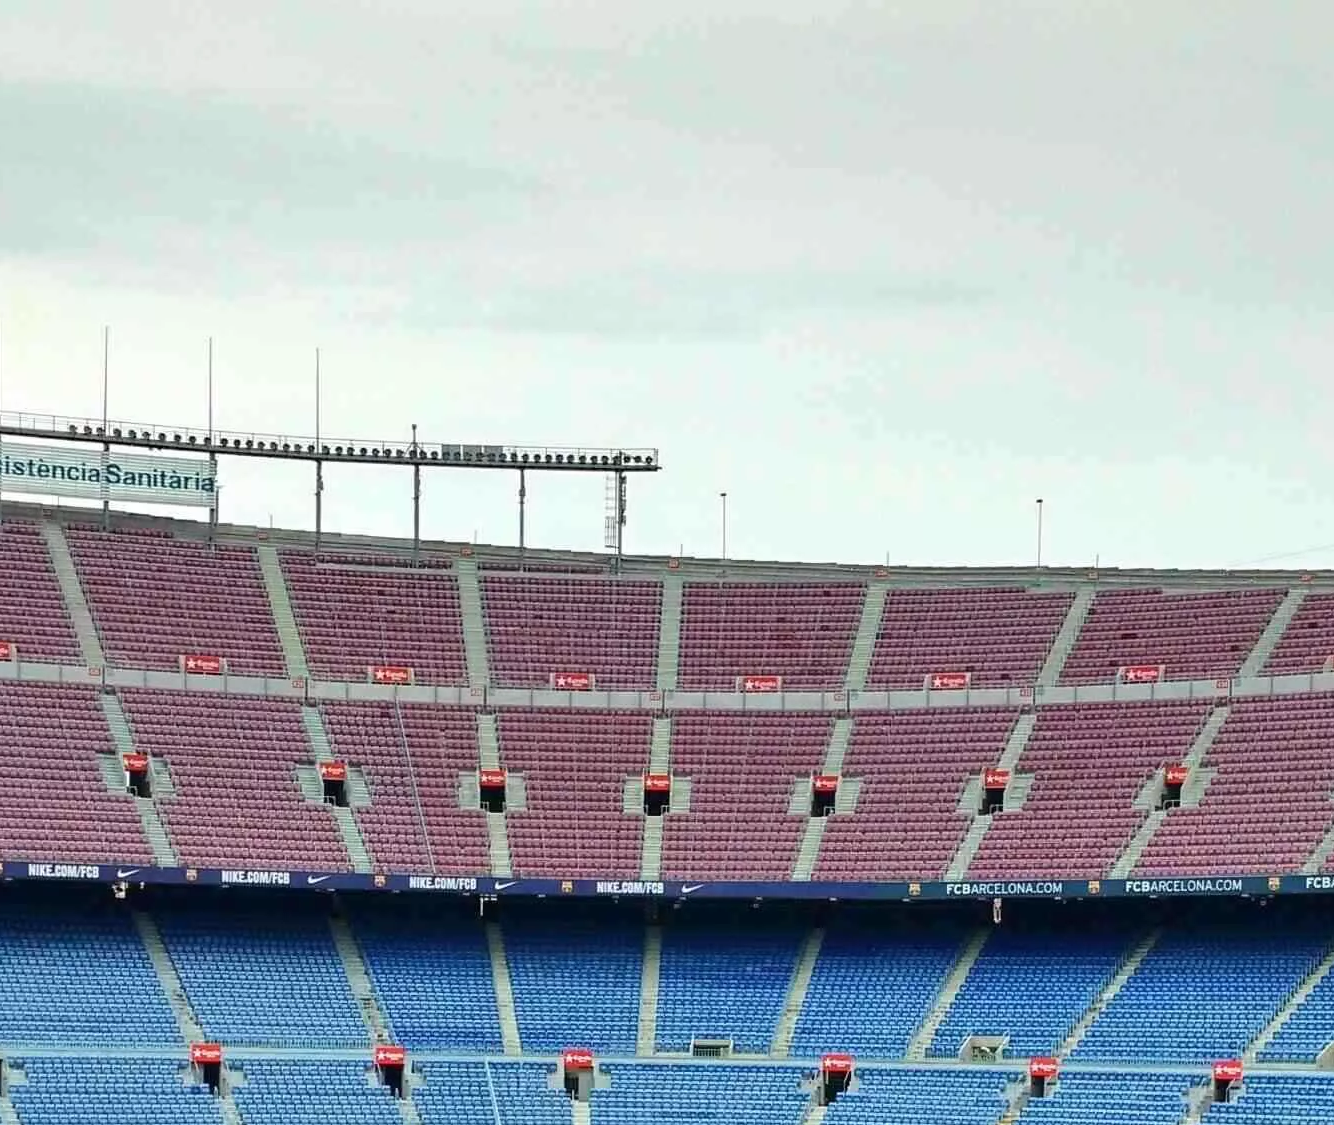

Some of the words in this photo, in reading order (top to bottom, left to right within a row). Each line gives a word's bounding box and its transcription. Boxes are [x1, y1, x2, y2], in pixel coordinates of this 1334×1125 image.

[105, 463, 216, 493] Sanitària
[28, 863, 99, 879] NIKE.COM/FCB
[221, 871, 290, 885] NIKE.COM/FCB
[409, 877, 477, 891] NIKE.COM/FCB
[596, 881, 664, 894] NIKE.COM/FCB
[946, 882, 1062, 895] FCBARCELONA.COM
[1125, 879, 1243, 893] FCBARCELONA.COM
